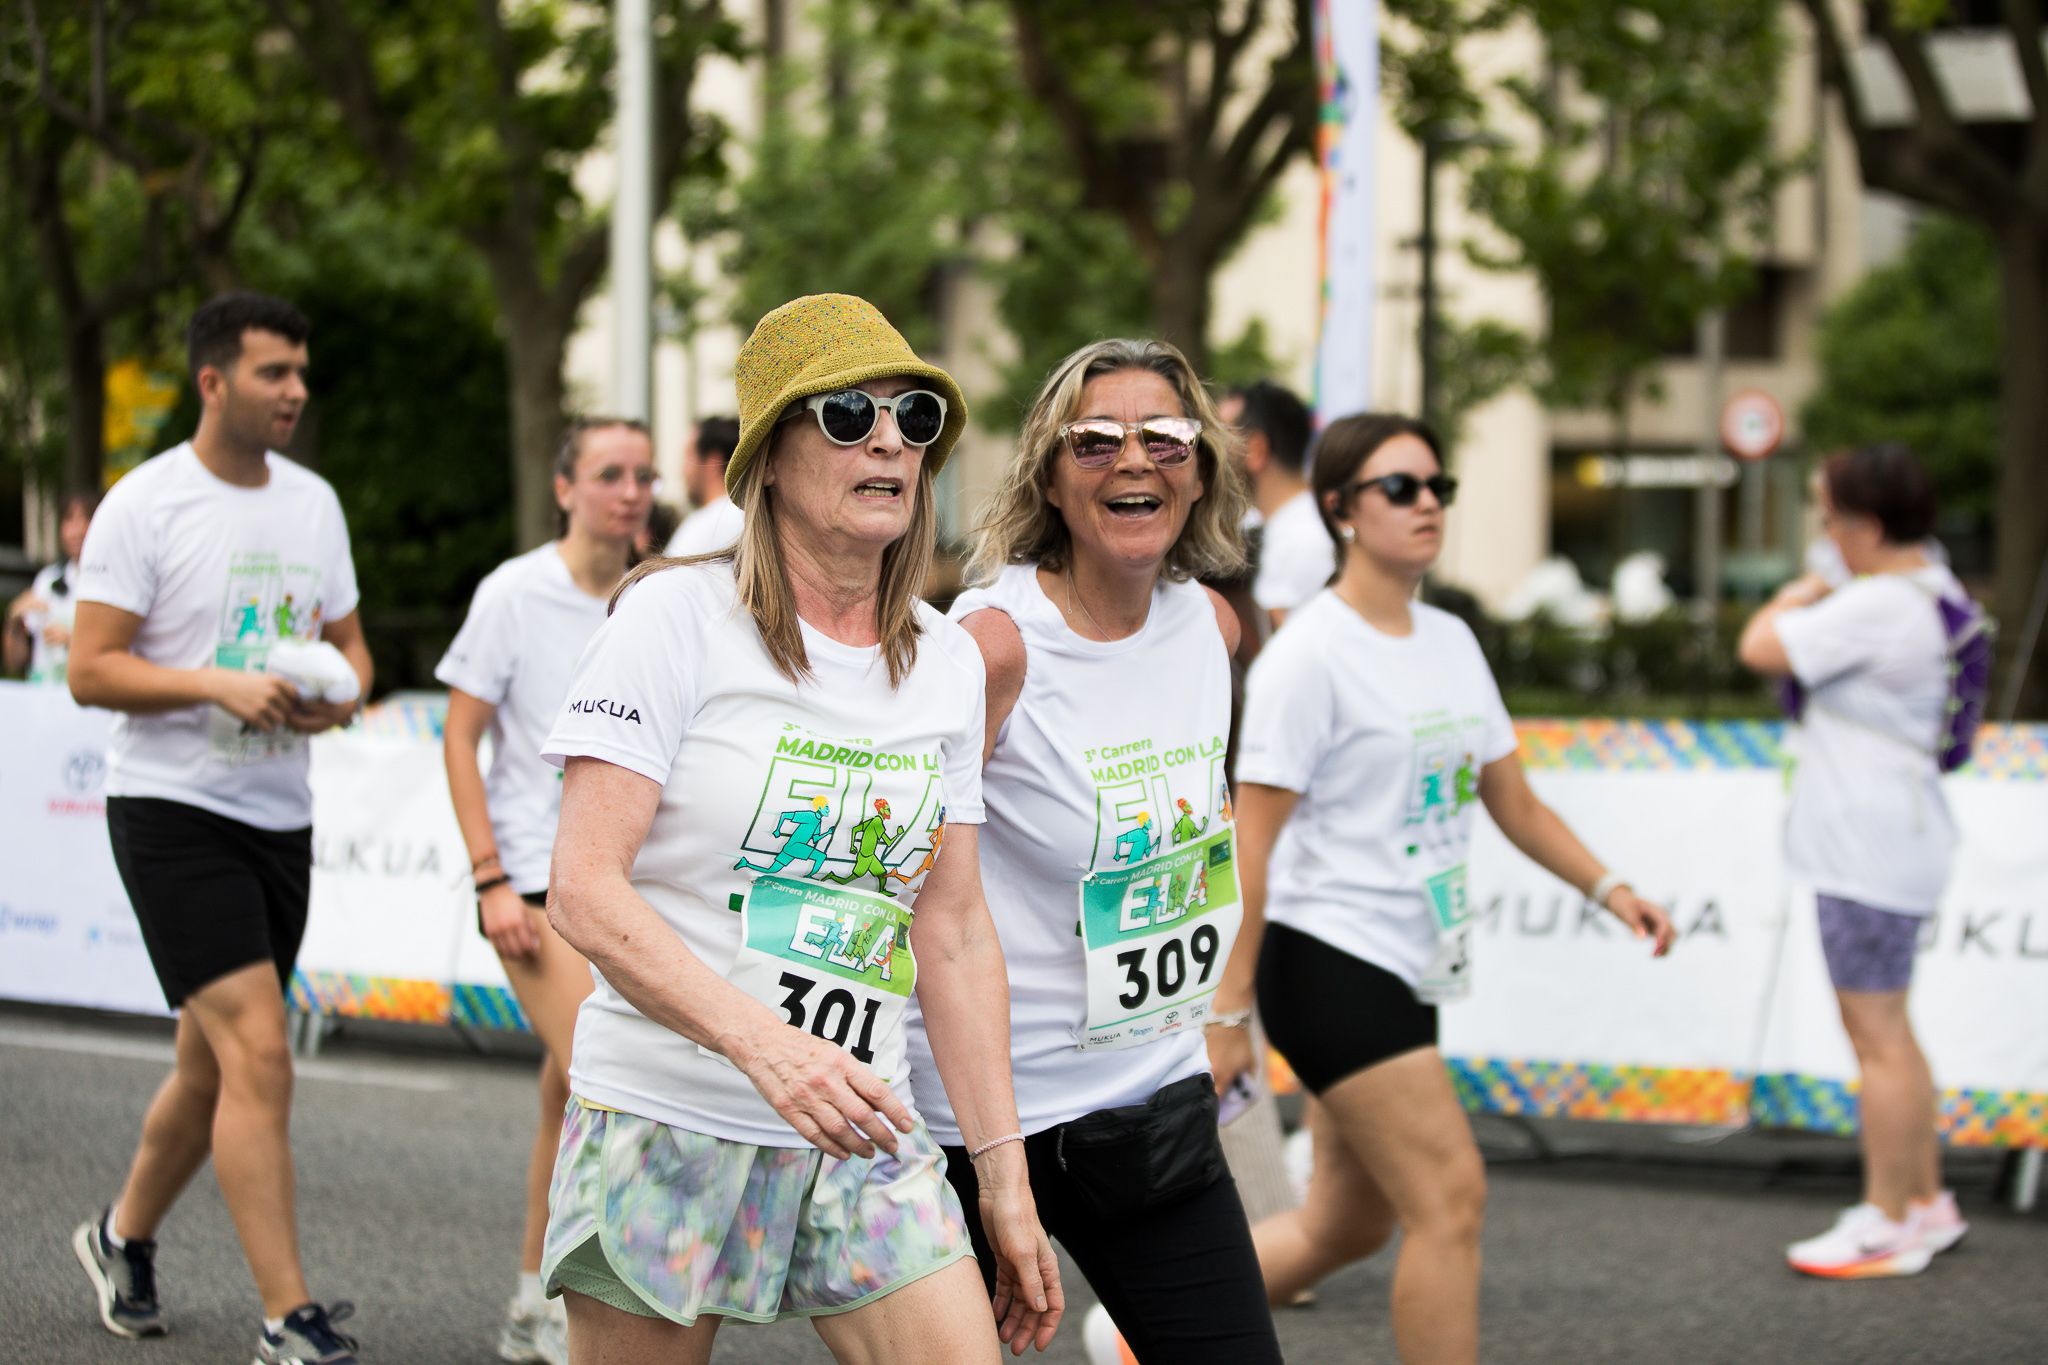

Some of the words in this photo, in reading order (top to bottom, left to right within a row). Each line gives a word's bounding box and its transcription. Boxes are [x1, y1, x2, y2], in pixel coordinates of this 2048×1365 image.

[568, 698, 642, 725] MUKUA
[776, 735, 874, 769] MADRID
[874, 752, 917, 771] CON
[1090, 755, 1160, 783] MADRID
[1164, 745, 1196, 768] CON
[1199, 735, 1225, 758] LA
[1101, 738, 1153, 760] Carrera
[1100, 876, 1129, 885] Carrera
[1130, 860, 1174, 881] MADRID
[1174, 853, 1194, 868] CON
[1193, 847, 1204, 860] LA
[772, 882, 803, 897] Carrera
[804, 890, 860, 911] MADRID
[863, 904, 887, 918] CON
[886, 911, 897, 923] LA
[1118, 860, 1208, 933] ELA
[788, 902, 897, 982] ELA
[1117, 924, 1220, 1010] 309
[778, 971, 882, 1065] 301
[1089, 1032, 1121, 1042] MUKUA
